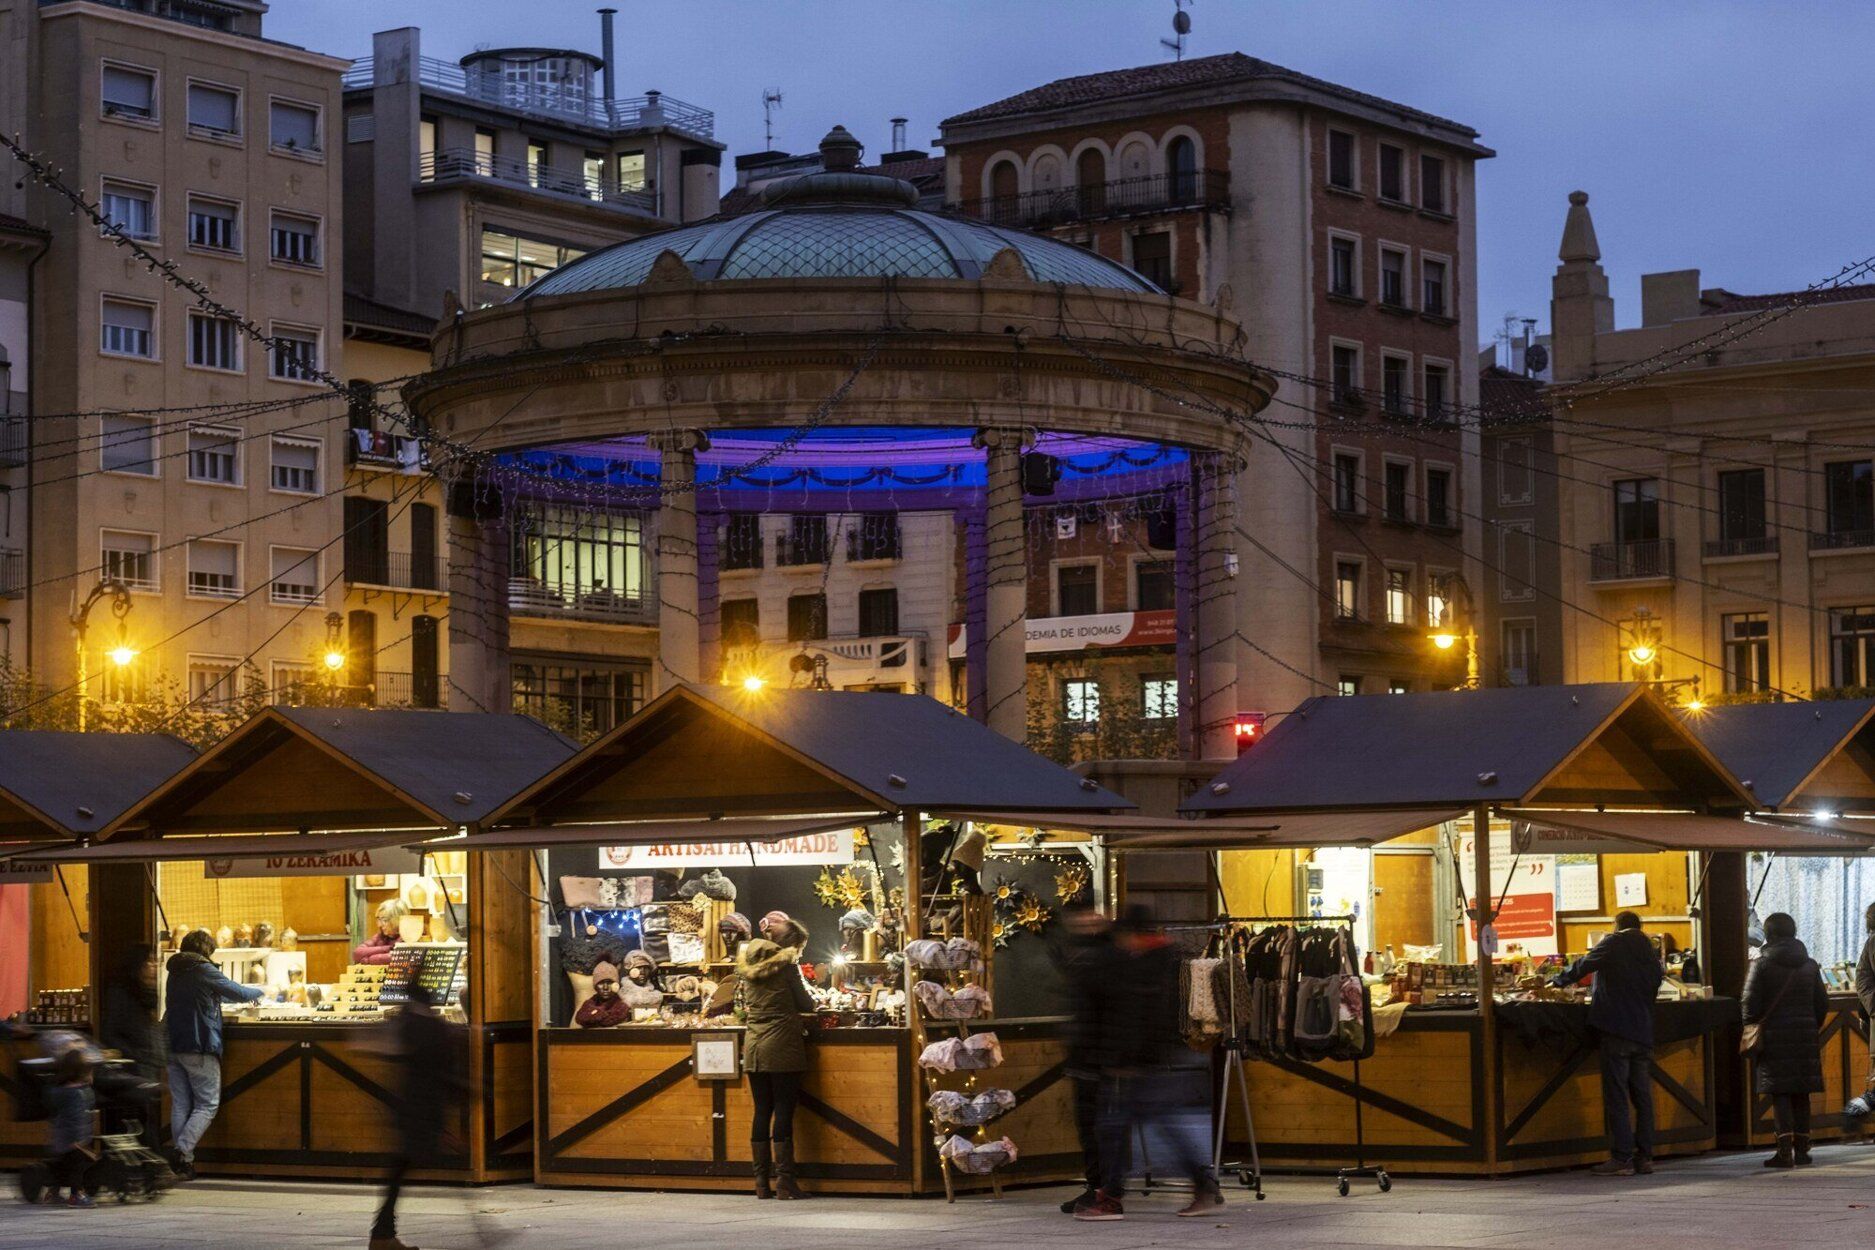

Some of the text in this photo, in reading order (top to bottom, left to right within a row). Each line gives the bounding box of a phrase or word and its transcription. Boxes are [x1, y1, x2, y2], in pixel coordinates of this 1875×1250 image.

[1060, 629, 1075, 639] DE
[1078, 624, 1122, 638] IDIOMAS
[728, 834, 839, 855] HANDMADE
[287, 850, 372, 868] ZERAMIKA
